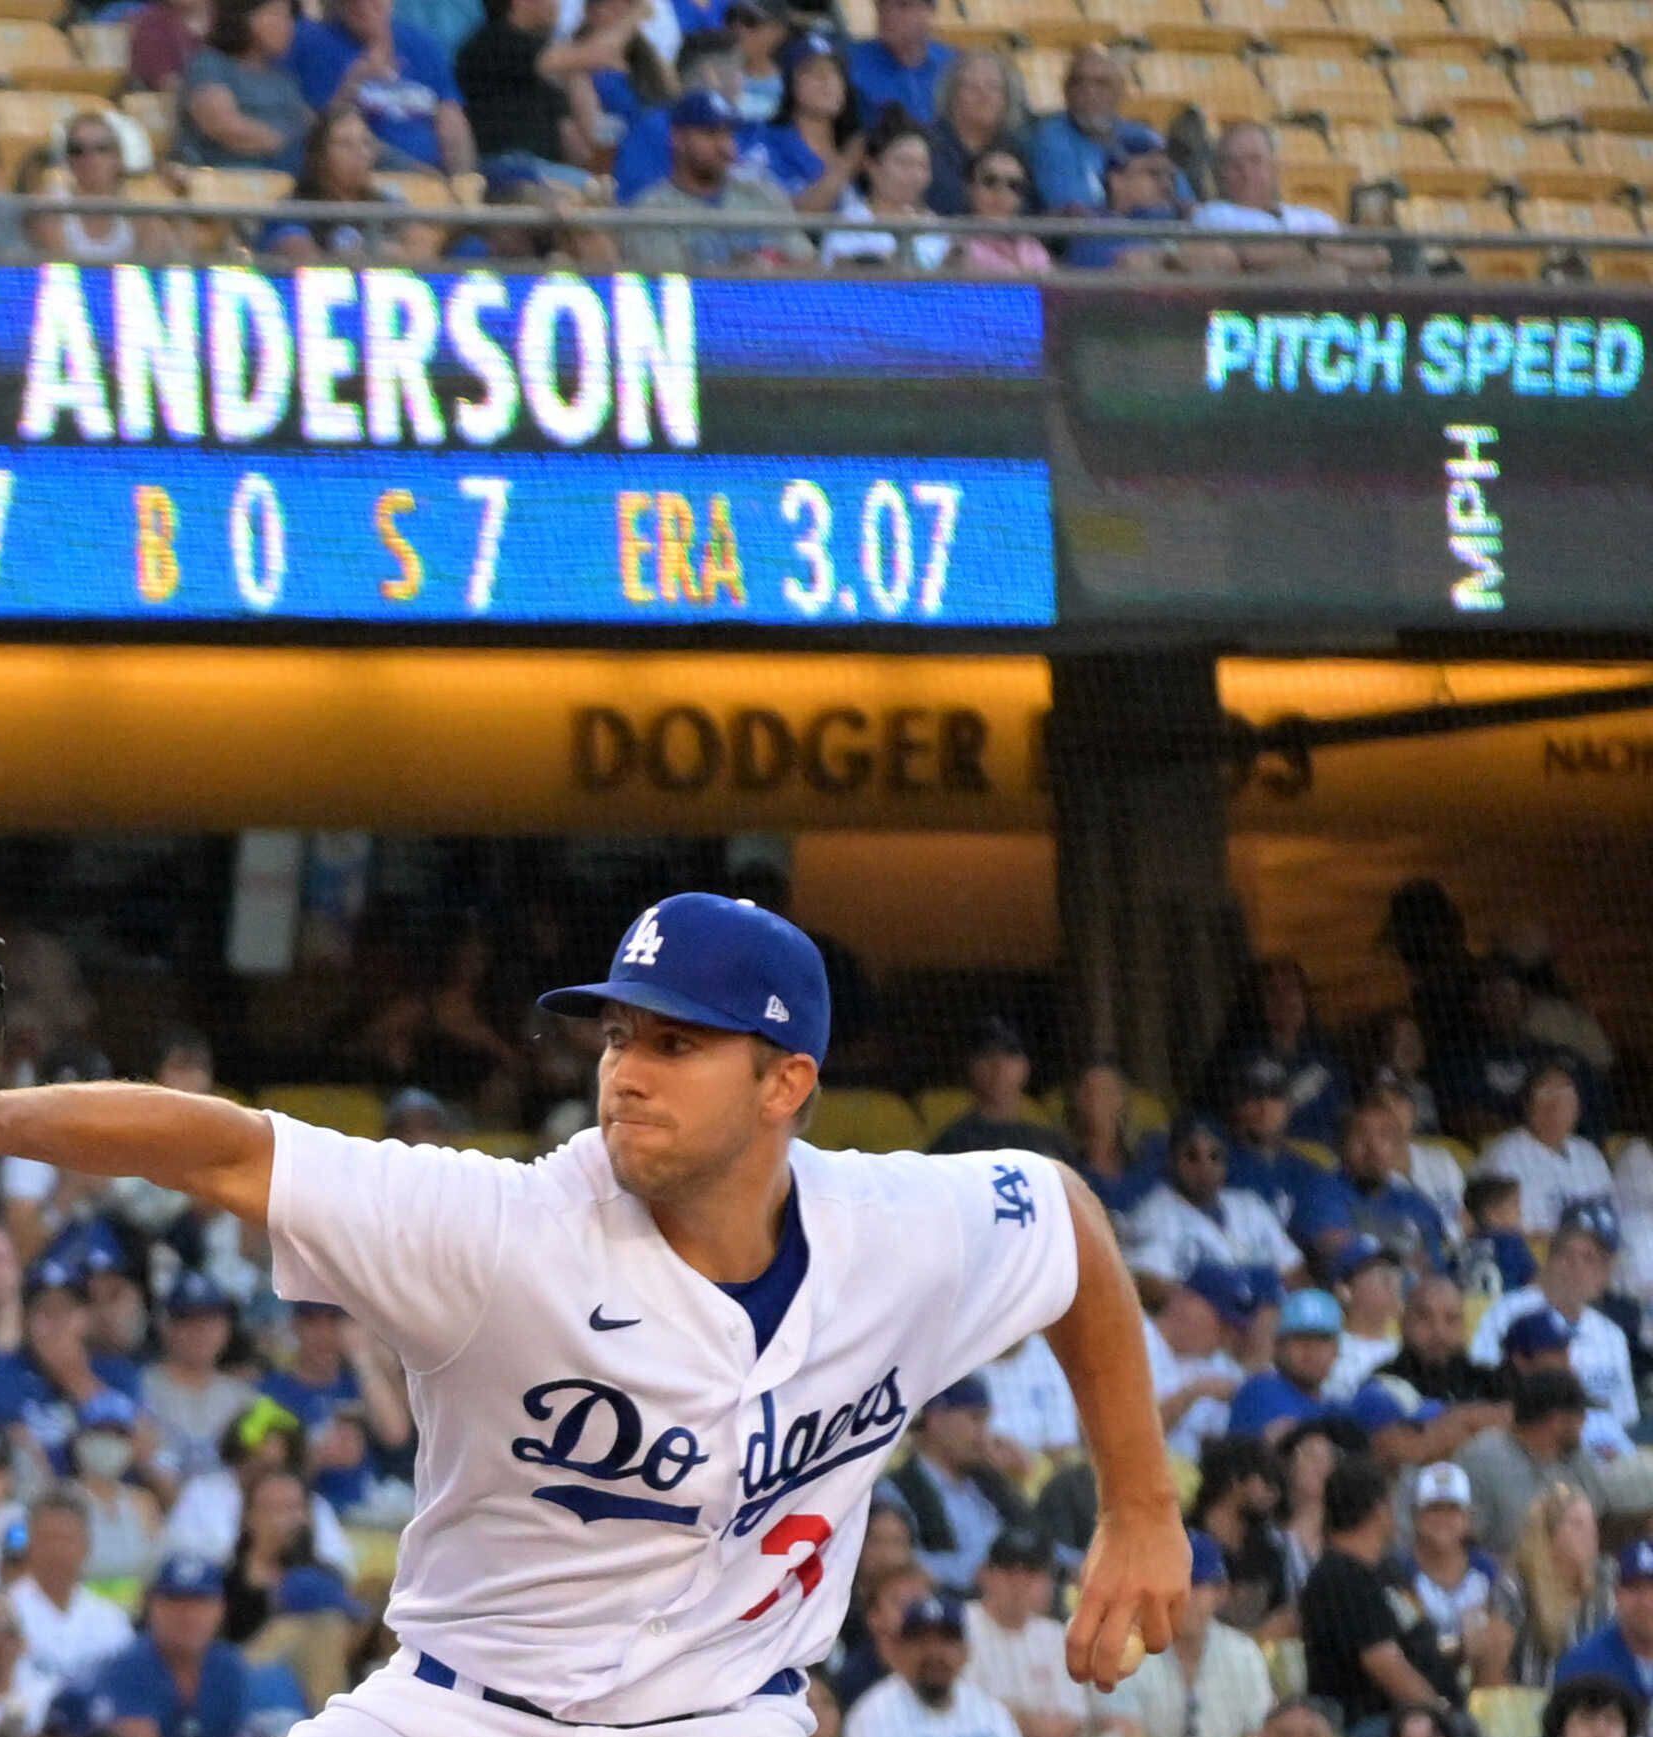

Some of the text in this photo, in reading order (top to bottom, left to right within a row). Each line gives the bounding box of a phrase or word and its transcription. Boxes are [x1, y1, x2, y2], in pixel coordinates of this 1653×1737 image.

[17, 259, 701, 450] ANDERSON
[1205, 309, 1646, 399] PITCH SPEED
[133, 484, 180, 603] B
[230, 473, 287, 614] 0
[375, 489, 425, 603] S
[458, 478, 512, 614] 7
[617, 488, 745, 606] ERA
[781, 478, 964, 619] 3.07
[1444, 424, 1505, 612] MPH
[573, 704, 991, 795] DODGER
[622, 906, 664, 965] LA
[511, 1366, 907, 1540] Dodgers
